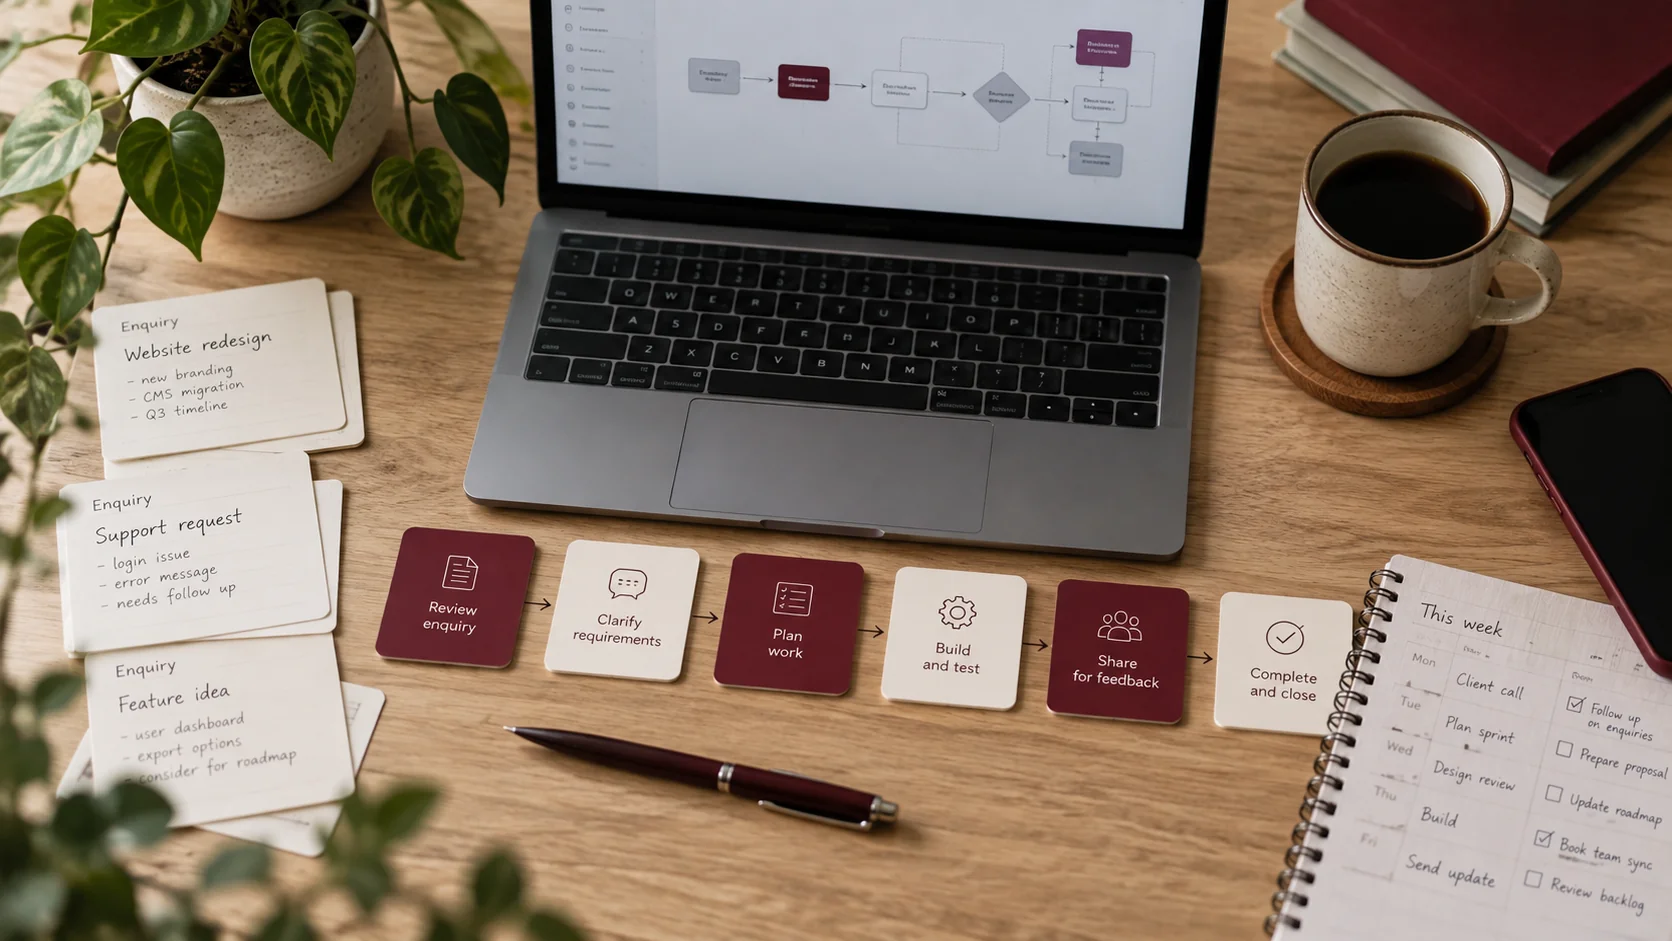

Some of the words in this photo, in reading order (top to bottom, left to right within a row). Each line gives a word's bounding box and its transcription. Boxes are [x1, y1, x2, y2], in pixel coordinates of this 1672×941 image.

[122, 319, 178, 333] Enquiry
[629, 316, 637, 324] A
[672, 320, 679, 328] S
[714, 323, 723, 331] D
[125, 342, 191, 361] Website
[203, 333, 271, 351] redesign
[645, 345, 652, 353] Z
[731, 352, 739, 360] C
[142, 376, 167, 384] new
[176, 364, 232, 379] branding
[144, 389, 172, 402] CMS
[182, 381, 244, 399] migration
[146, 408, 165, 420] Q3
[174, 401, 227, 416] timeline
[93, 496, 151, 512] Enquiry
[96, 520, 166, 547] Support
[179, 508, 242, 536] request
[114, 557, 146, 573] login
[157, 551, 190, 562] issue
[115, 577, 150, 589] error
[160, 567, 217, 582] message
[118, 593, 157, 608] needs
[167, 586, 210, 605] follow
[220, 584, 235, 597] up
[429, 602, 477, 615] Review
[423, 621, 476, 635] enquiry
[598, 614, 642, 630] Clarify
[1421, 603, 1453, 624] This
[1464, 620, 1502, 637] week
[574, 632, 661, 646] requirements
[774, 629, 802, 641] Plan
[769, 647, 803, 658] work
[936, 642, 971, 656] Build
[923, 660, 949, 671] and
[954, 663, 980, 674] test
[1098, 655, 1137, 669] Share
[1412, 653, 1435, 667] Mon
[116, 662, 175, 679] Enquiry
[1073, 670, 1092, 682] for
[1097, 672, 1159, 688] feedback
[1251, 668, 1317, 684] Complete
[1251, 687, 1276, 697] and
[1282, 688, 1316, 701] close
[1457, 673, 1494, 692] Client
[1501, 686, 1524, 700] call
[119, 693, 184, 712] Feature
[196, 683, 229, 700] idea
[1401, 695, 1421, 710] Tue
[1590, 703, 1622, 719] Follow
[1629, 716, 1641, 727] up
[136, 729, 165, 740] user
[175, 713, 244, 734] dashboard
[1446, 716, 1471, 732] Plan
[1479, 729, 1514, 744] sprint
[1606, 723, 1653, 741] enquiries
[138, 748, 182, 764] export
[192, 738, 241, 754] options
[1388, 740, 1413, 756] Wed
[139, 765, 198, 784] consider
[207, 760, 227, 775] for
[237, 751, 296, 766] roadmap
[1580, 748, 1619, 768] Prepare
[1624, 763, 1668, 779] proposal
[1434, 760, 1472, 785] Design
[1479, 777, 1515, 790] review
[1375, 785, 1396, 801] Thu
[1421, 807, 1458, 828] Build
[1571, 794, 1609, 813] Update
[1616, 808, 1662, 829] roadmap
[1559, 837, 1586, 857] Book
[1592, 847, 1620, 865] team
[1628, 858, 1652, 873] sync
[1406, 854, 1442, 875] Send
[1448, 869, 1494, 887] update
[1551, 877, 1592, 898] Review
[1600, 888, 1644, 917] backlog
